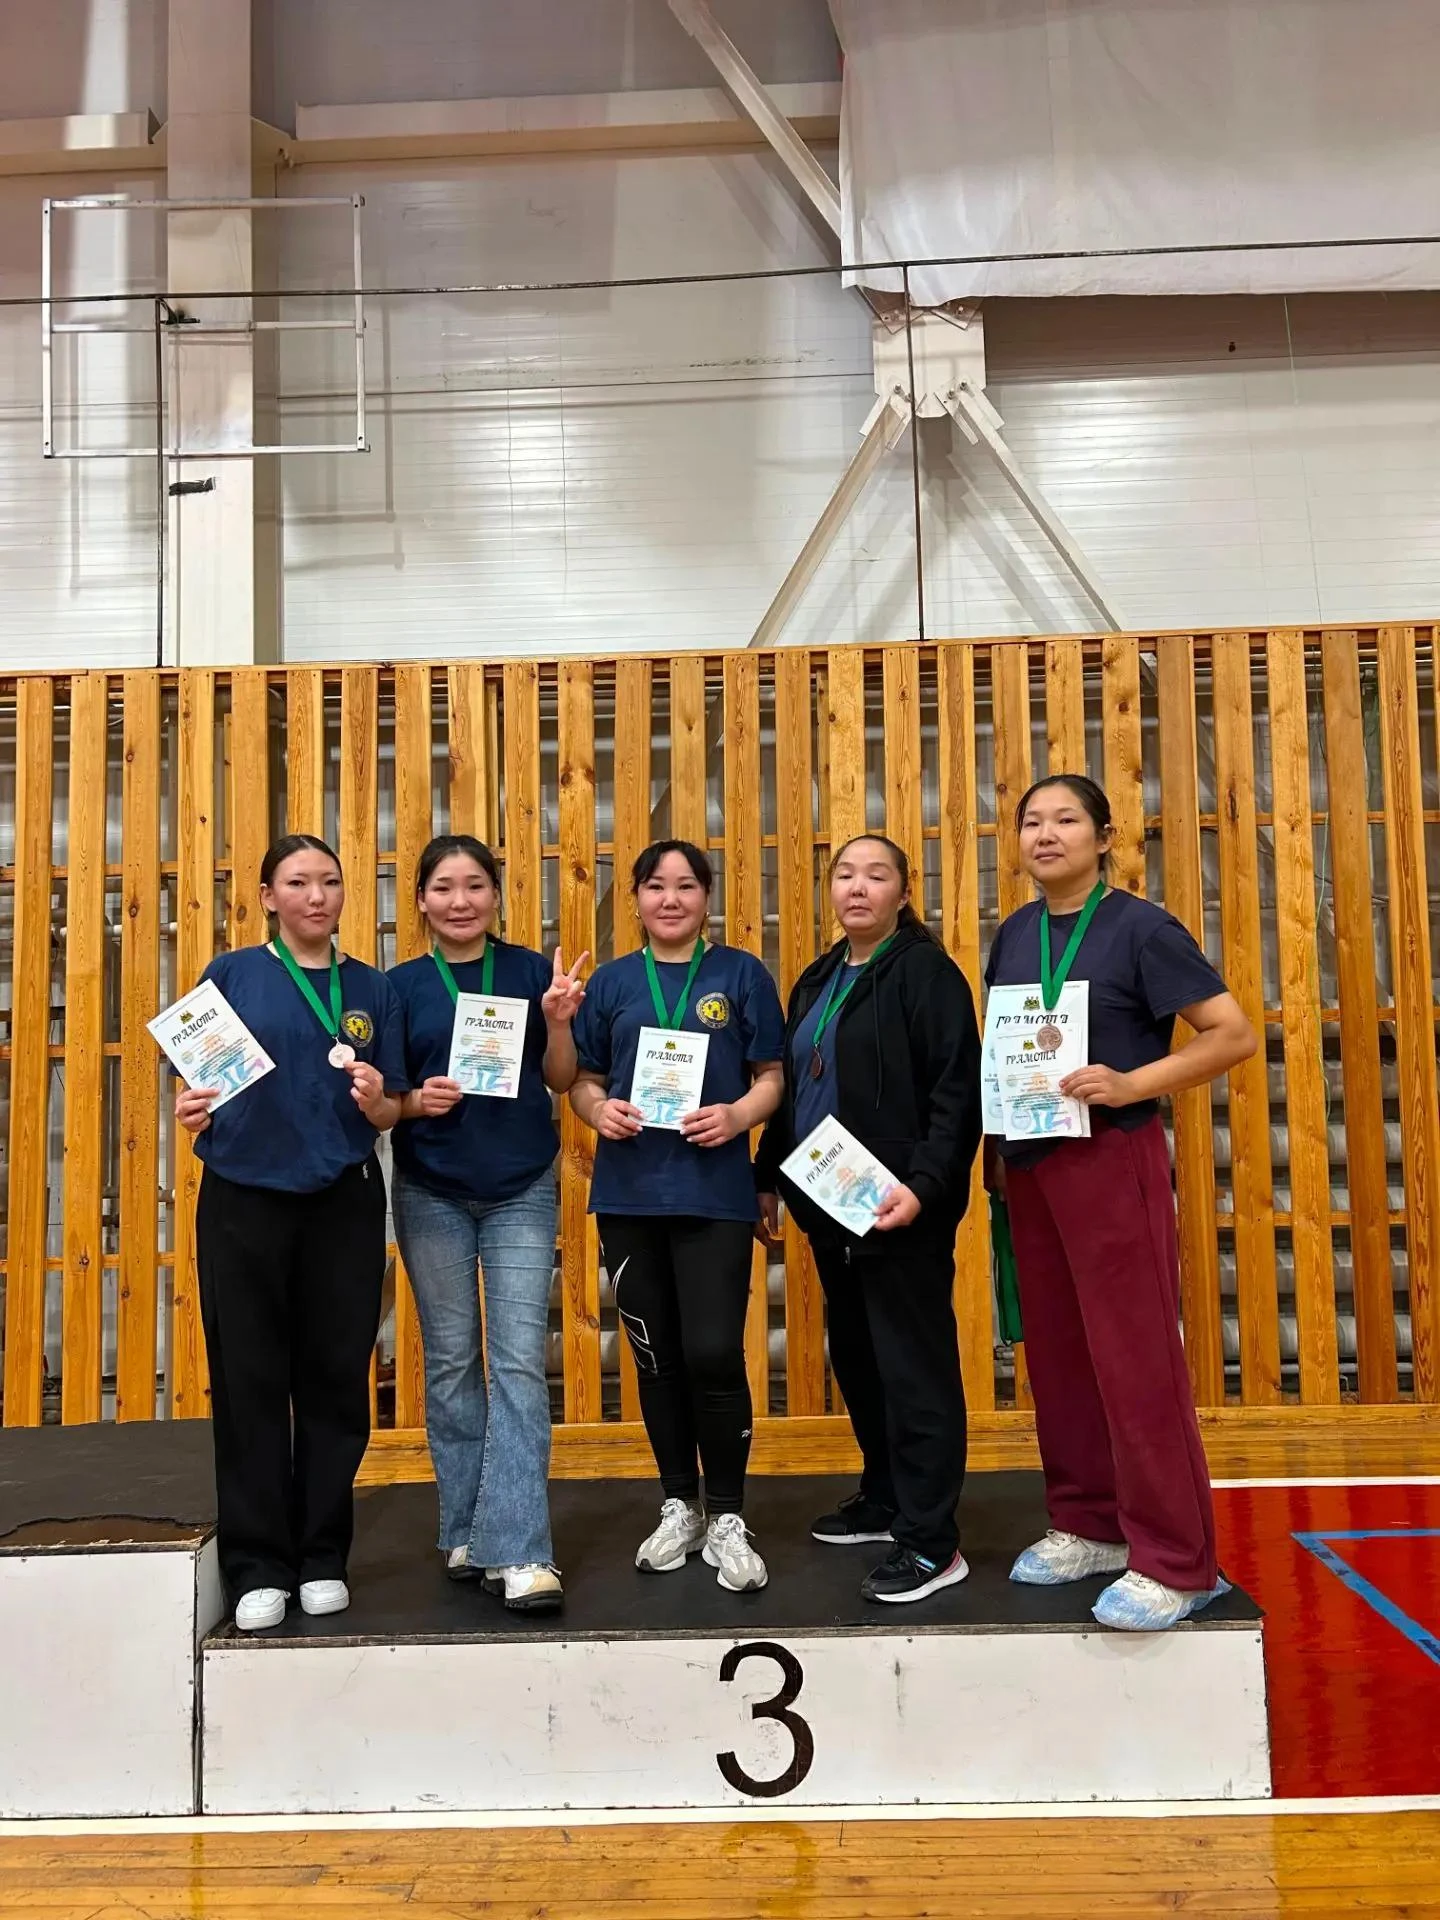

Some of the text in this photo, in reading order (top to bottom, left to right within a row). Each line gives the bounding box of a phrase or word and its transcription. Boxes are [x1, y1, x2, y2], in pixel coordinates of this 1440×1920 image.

[171, 1007, 219, 1047] ГРАМОТА
[464, 1017, 515, 1030] ГРАМОТА
[646, 1050, 694, 1063] ГРАМОТА
[1006, 1050, 1057, 1065] ГРАМОТА
[805, 1141, 845, 1185] ГРАМОТА
[716, 1641, 815, 1798] 3
